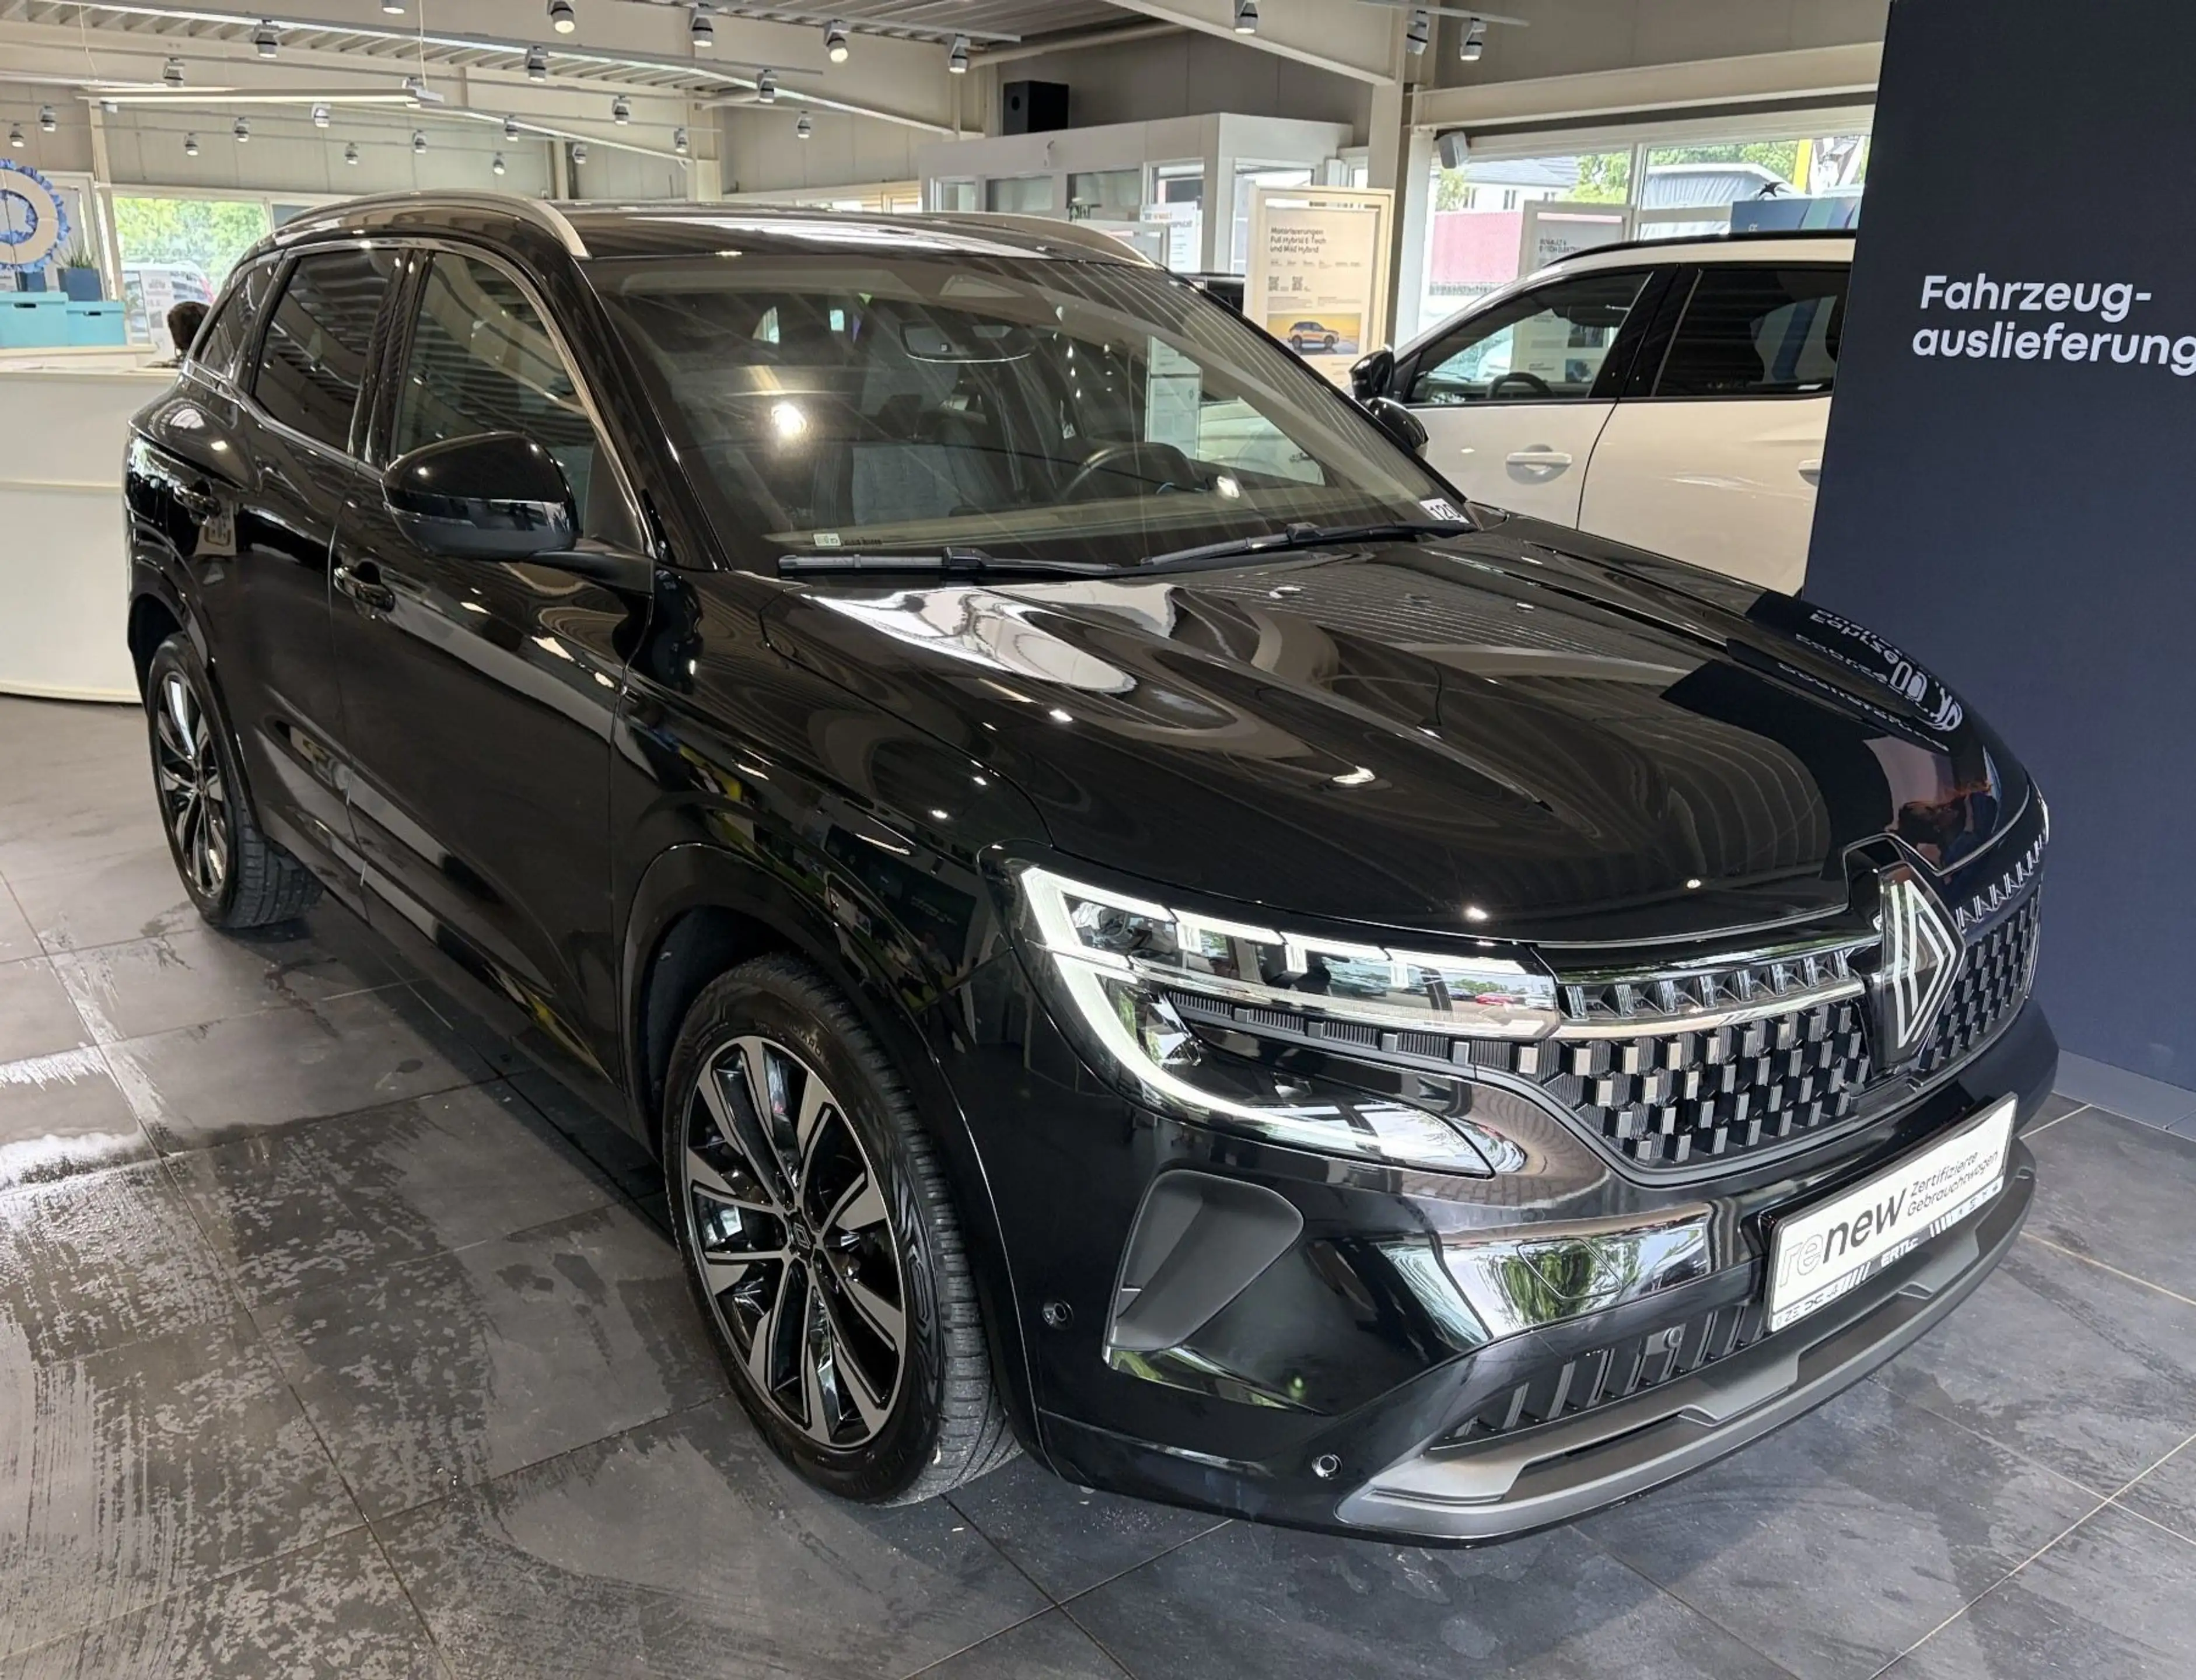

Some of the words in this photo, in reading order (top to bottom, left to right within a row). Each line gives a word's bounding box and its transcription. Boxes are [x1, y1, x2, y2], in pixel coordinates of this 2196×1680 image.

[1919, 272, 2152, 323] Fahrzeug-
[1912, 321, 2196, 377] auslieferung
[1907, 1150, 1999, 1217] Gebrauchtwagen
[1910, 1152, 1978, 1197] Zertifizierte
[1779, 1188, 1907, 1288] renew
